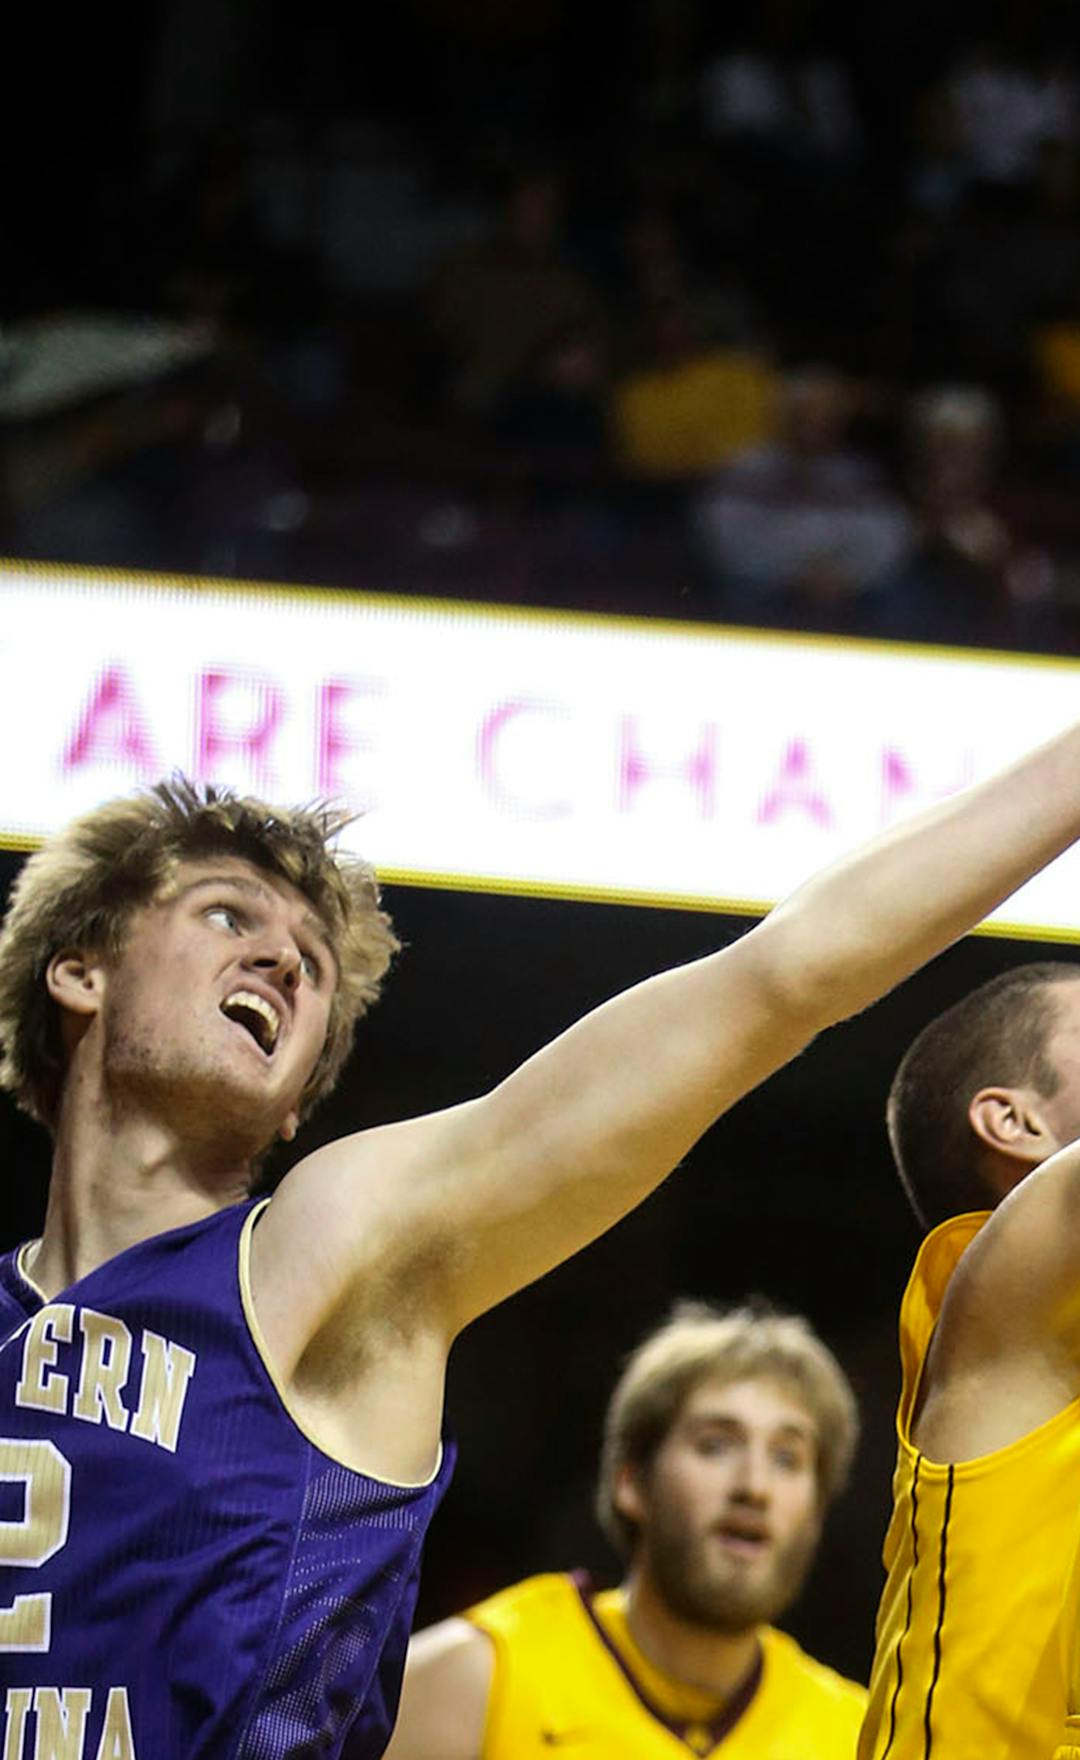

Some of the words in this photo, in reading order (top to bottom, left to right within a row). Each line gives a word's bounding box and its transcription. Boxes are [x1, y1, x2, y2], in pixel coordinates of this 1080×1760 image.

[58, 655, 388, 806] ARE
[15, 1303, 196, 1453] ERN
[2, 1686, 137, 1760] INA
